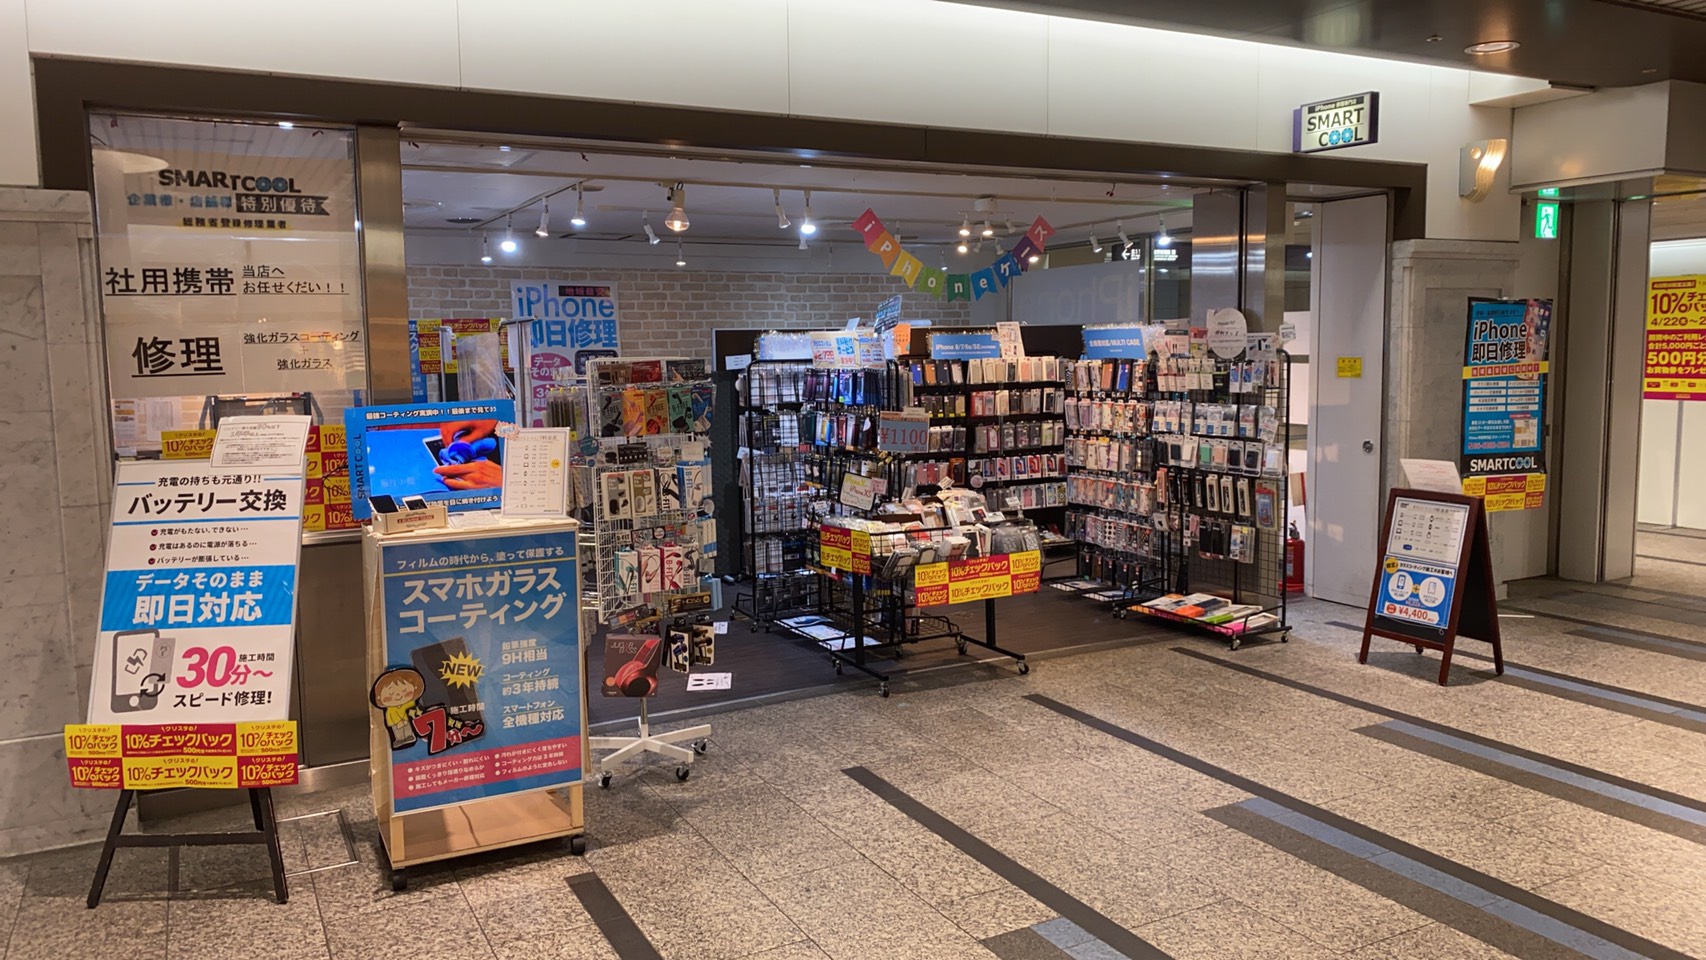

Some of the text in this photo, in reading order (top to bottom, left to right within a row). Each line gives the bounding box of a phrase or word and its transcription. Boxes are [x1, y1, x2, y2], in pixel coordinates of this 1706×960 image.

[1307, 107, 1364, 132] SMART
[1318, 127, 1363, 146] COOL
[158, 169, 301, 193] SMARTCOOL
[241, 196, 316, 213] 特別優待
[183, 217, 287, 229] 総務省登録修理業者
[243, 264, 285, 277] 当店へ
[105, 267, 234, 294] 社用携帯
[516, 284, 615, 318] iPhone
[1652, 292, 1688, 314] 10%
[243, 331, 360, 345] 強化ガラスコーティング
[1474, 319, 1528, 341] iPhone
[131, 336, 222, 374] 修理
[1472, 341, 1527, 363] 即日修理
[277, 358, 333, 370] 強化ガラス
[533, 358, 561, 366] データ
[166, 440, 189, 453] 10%
[324, 433, 345, 444] 10%
[1470, 456, 1537, 472] SMARTCOOL
[158, 475, 261, 487] 充電の持ちも元通り!!
[128, 489, 287, 515] バッテリー交換
[328, 511, 351, 524] 10%
[397, 546, 564, 570] フィルムの時代から、塗って保護する
[951, 561, 1008, 577] 10%チェックバック
[136, 571, 264, 592] データそのまま
[402, 566, 561, 606] スマホガラス
[951, 582, 1009, 598] 10%チェックバック
[133, 591, 263, 625] 即日対応
[399, 592, 567, 634] コーティング
[1399, 606, 1428, 620] ¥4,400
[239, 653, 275, 663] 施工時間
[502, 649, 547, 665] 9H相当
[444, 662, 482, 677] NEW
[503, 668, 550, 682] コーティング
[502, 678, 559, 696] 約3年持続
[173, 691, 272, 708] スピード修理!
[503, 700, 555, 713] スマートフォン
[450, 703, 485, 715] 施工時間
[503, 709, 565, 729] 全機種対応
[69, 734, 94, 750] 10%
[125, 733, 232, 749] 10%チェックバック
[240, 731, 293, 748] 10% チェック
[72, 767, 96, 781] 10%
[127, 766, 233, 781] 10%チェックバック
[240, 764, 266, 781] 10%
[267, 770, 294, 779] バック
